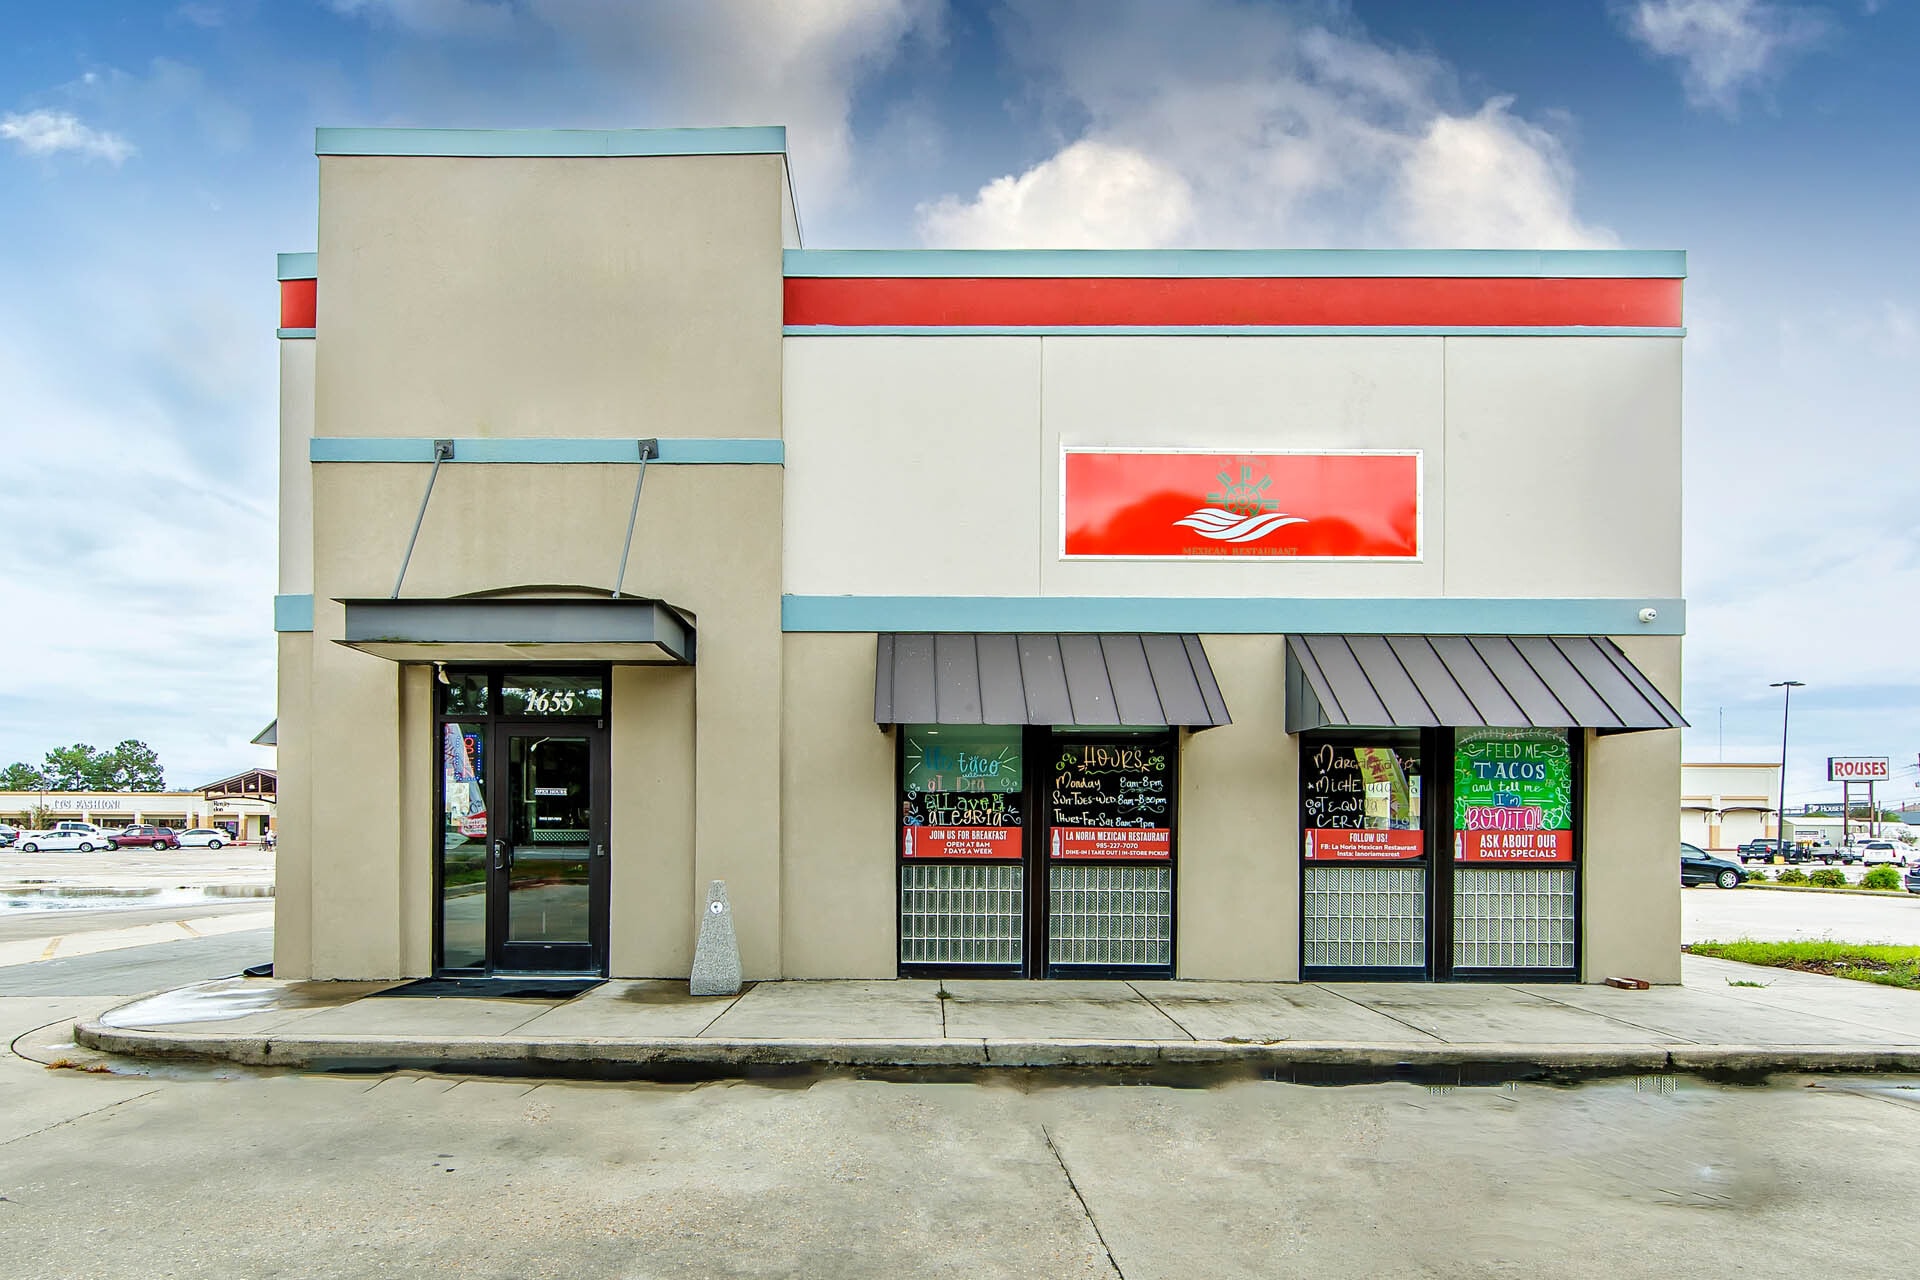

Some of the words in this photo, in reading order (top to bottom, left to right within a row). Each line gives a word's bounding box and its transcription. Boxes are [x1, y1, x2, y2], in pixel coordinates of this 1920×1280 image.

[524, 690, 576, 712] 1655
[1084, 745, 1143, 769] HOURS
[1486, 742, 1521, 759] FEED
[1525, 743, 1542, 759] ME
[957, 752, 1003, 775] taco
[1473, 761, 1546, 779] TACOS
[1834, 761, 1887, 776] ROUSES
[1055, 771, 1101, 792] Monday
[1472, 780, 1493, 792] and
[1498, 781, 1520, 792] tell
[1523, 784, 1544, 792] me
[929, 830, 945, 840] JOIN
[947, 830, 956, 840] US
[957, 830, 970, 840] FOR
[972, 830, 1008, 841] BREAKFAST
[1065, 831, 1074, 841] LA
[1075, 831, 1096, 841] NORIA
[1097, 831, 1127, 841] MEXICAN
[1128, 832, 1169, 842] RESTAURANT
[1349, 832, 1375, 843] FOLLOW
[1376, 833, 1388, 843] US!
[1480, 834, 1500, 848] ASK
[1502, 834, 1534, 848] ABOUT
[1537, 834, 1557, 848] OUR
[1480, 849, 1508, 858] DAILY
[1510, 849, 1558, 859] SPECIALS
